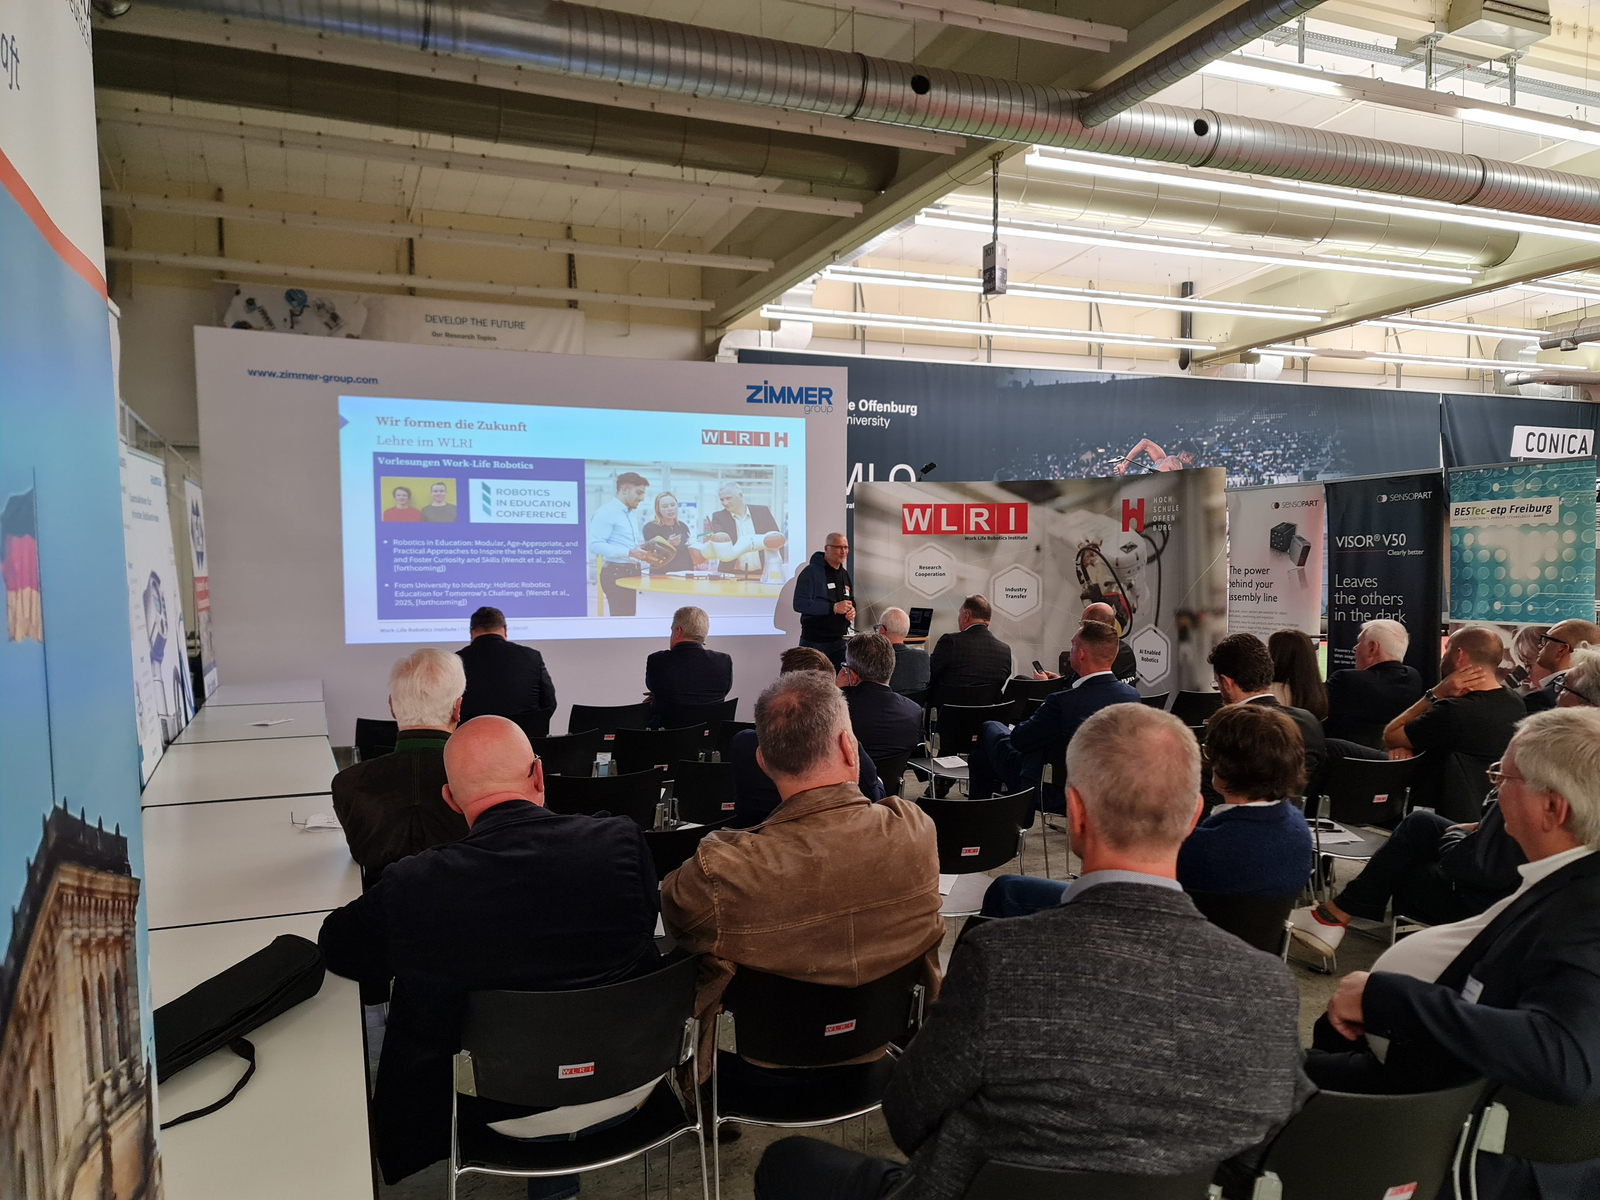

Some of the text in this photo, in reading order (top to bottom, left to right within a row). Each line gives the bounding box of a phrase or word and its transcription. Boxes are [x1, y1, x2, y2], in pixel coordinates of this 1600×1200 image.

[425, 314, 526, 330] DEVELOP THE FUTURE
[247, 368, 379, 385] www.zimmer-group.com
[804, 405, 834, 415] group
[858, 399, 918, 416] Offenburg
[376, 416, 527, 432] Wir formen die Zukunft
[846, 415, 891, 429] niversity
[376, 435, 473, 448] Lehre im WLRI
[702, 430, 770, 447] WLRI
[1525, 431, 1588, 455] CONICA
[378, 456, 534, 470] Vorlesungen Work-Life Robotics
[496, 488, 550, 497] ROBOTICS
[510, 500, 571, 508] EDUCATION
[1153, 504, 1180, 513] SCHULE
[496, 510, 567, 518] CONFERENCE
[1454, 504, 1553, 516] BESTec-etp Freiburg
[903, 506, 1016, 531] WLRI
[1152, 524, 1172, 532] BURG
[393, 538, 425, 546] Robotics
[435, 539, 474, 547] Education:
[474, 540, 506, 548] Modular,
[506, 540, 564, 549] Age-Appropriate,
[1382, 533, 1406, 546] V50
[426, 548, 470, 556] Approaches
[480, 548, 503, 556] Inspire
[434, 556, 465, 565] Curiosity
[501, 556, 526, 564] (Wendt
[1229, 566, 1270, 577] The power
[415, 582, 452, 590] University
[461, 582, 492, 590] Industry:
[1255, 581, 1274, 592] your
[1335, 574, 1378, 588] Leaves
[488, 590, 524, 598] Challenge.
[526, 589, 550, 597] (Wendt
[1263, 593, 1278, 602] line
[1334, 590, 1404, 606] the others
[394, 599, 414, 607] 2025,
[1334, 608, 1406, 623] in the dark
[825, 1022, 855, 1033] WLRI
[562, 1065, 594, 1076] WLRI
